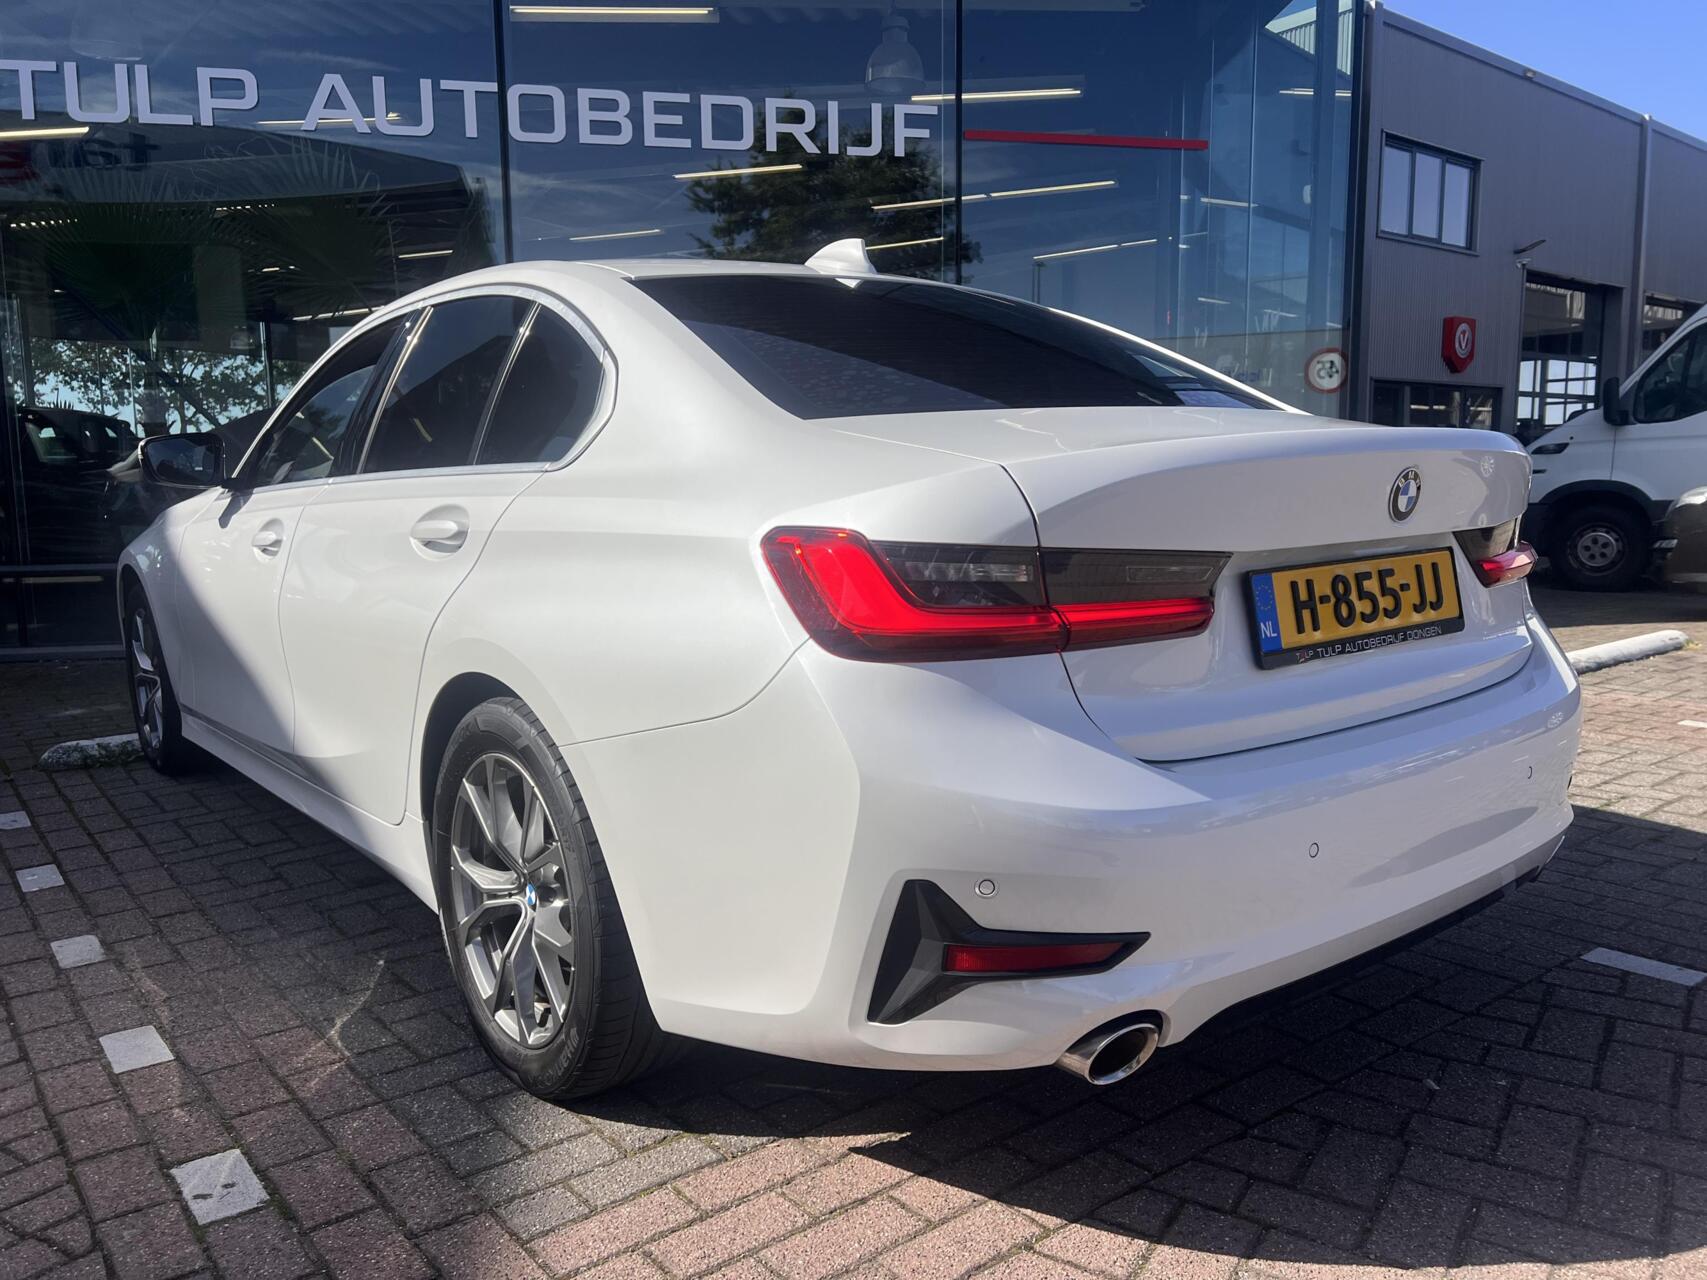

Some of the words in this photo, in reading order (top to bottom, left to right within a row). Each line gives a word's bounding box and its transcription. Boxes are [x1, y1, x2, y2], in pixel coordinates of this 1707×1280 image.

[0, 60, 259, 126] TULP
[301, 73, 940, 158] AUTOBEDRIJF
[1290, 562, 1444, 635] H-855-JJ
[1260, 621, 1277, 639] NL
[1316, 644, 1342, 658] TULP
[1345, 632, 1405, 653] AUTOBEDRIJF
[1406, 625, 1442, 640] DONGEN
